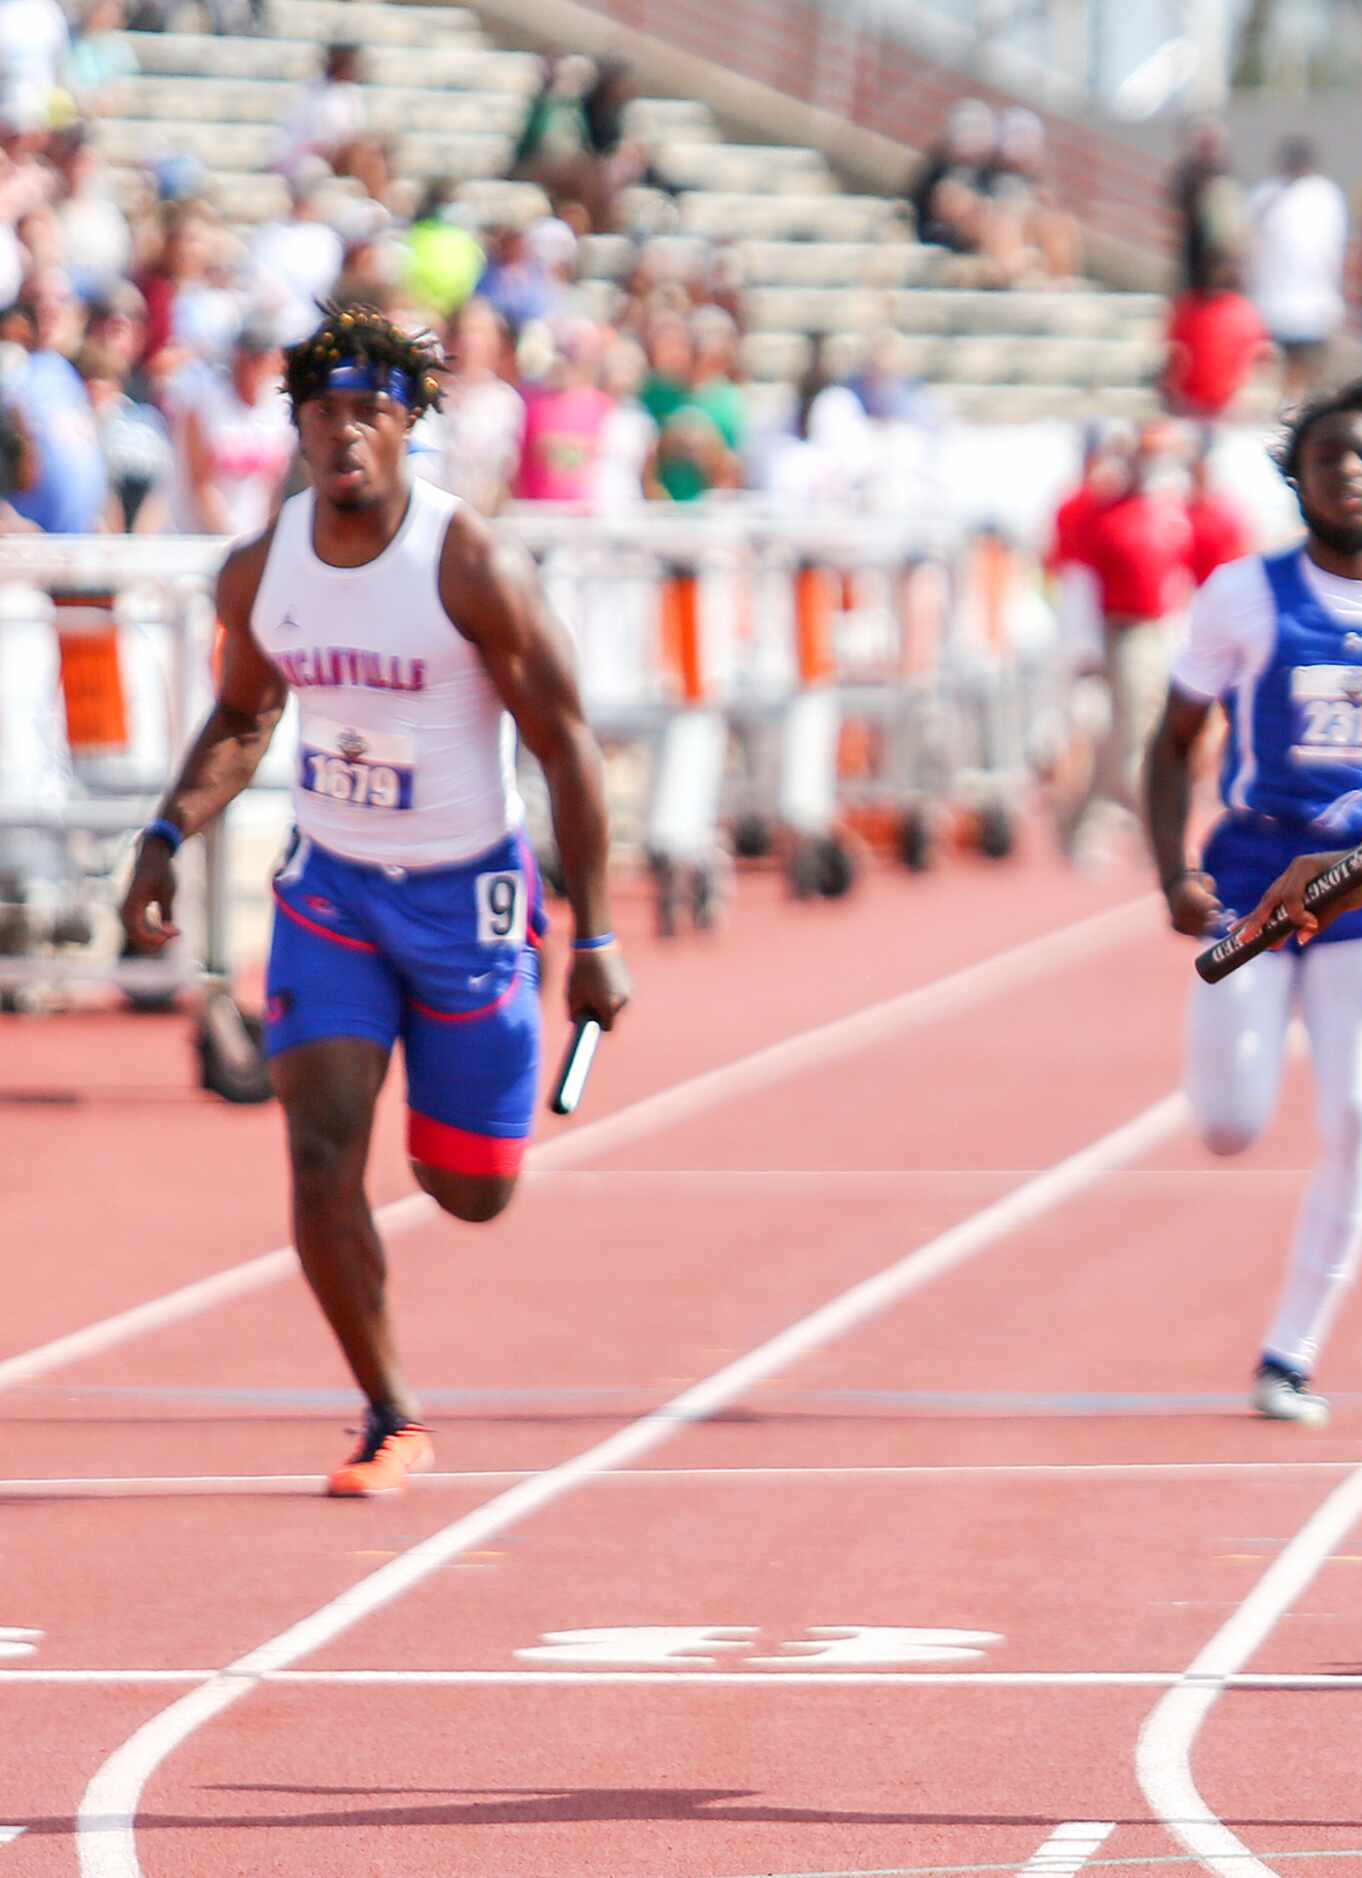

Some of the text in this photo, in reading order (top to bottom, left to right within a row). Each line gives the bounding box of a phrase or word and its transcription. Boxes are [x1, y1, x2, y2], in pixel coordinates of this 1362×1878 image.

[277, 645, 427, 692] NCANVILLE
[311, 755, 399, 808] 1679
[489, 874, 517, 936] 9
